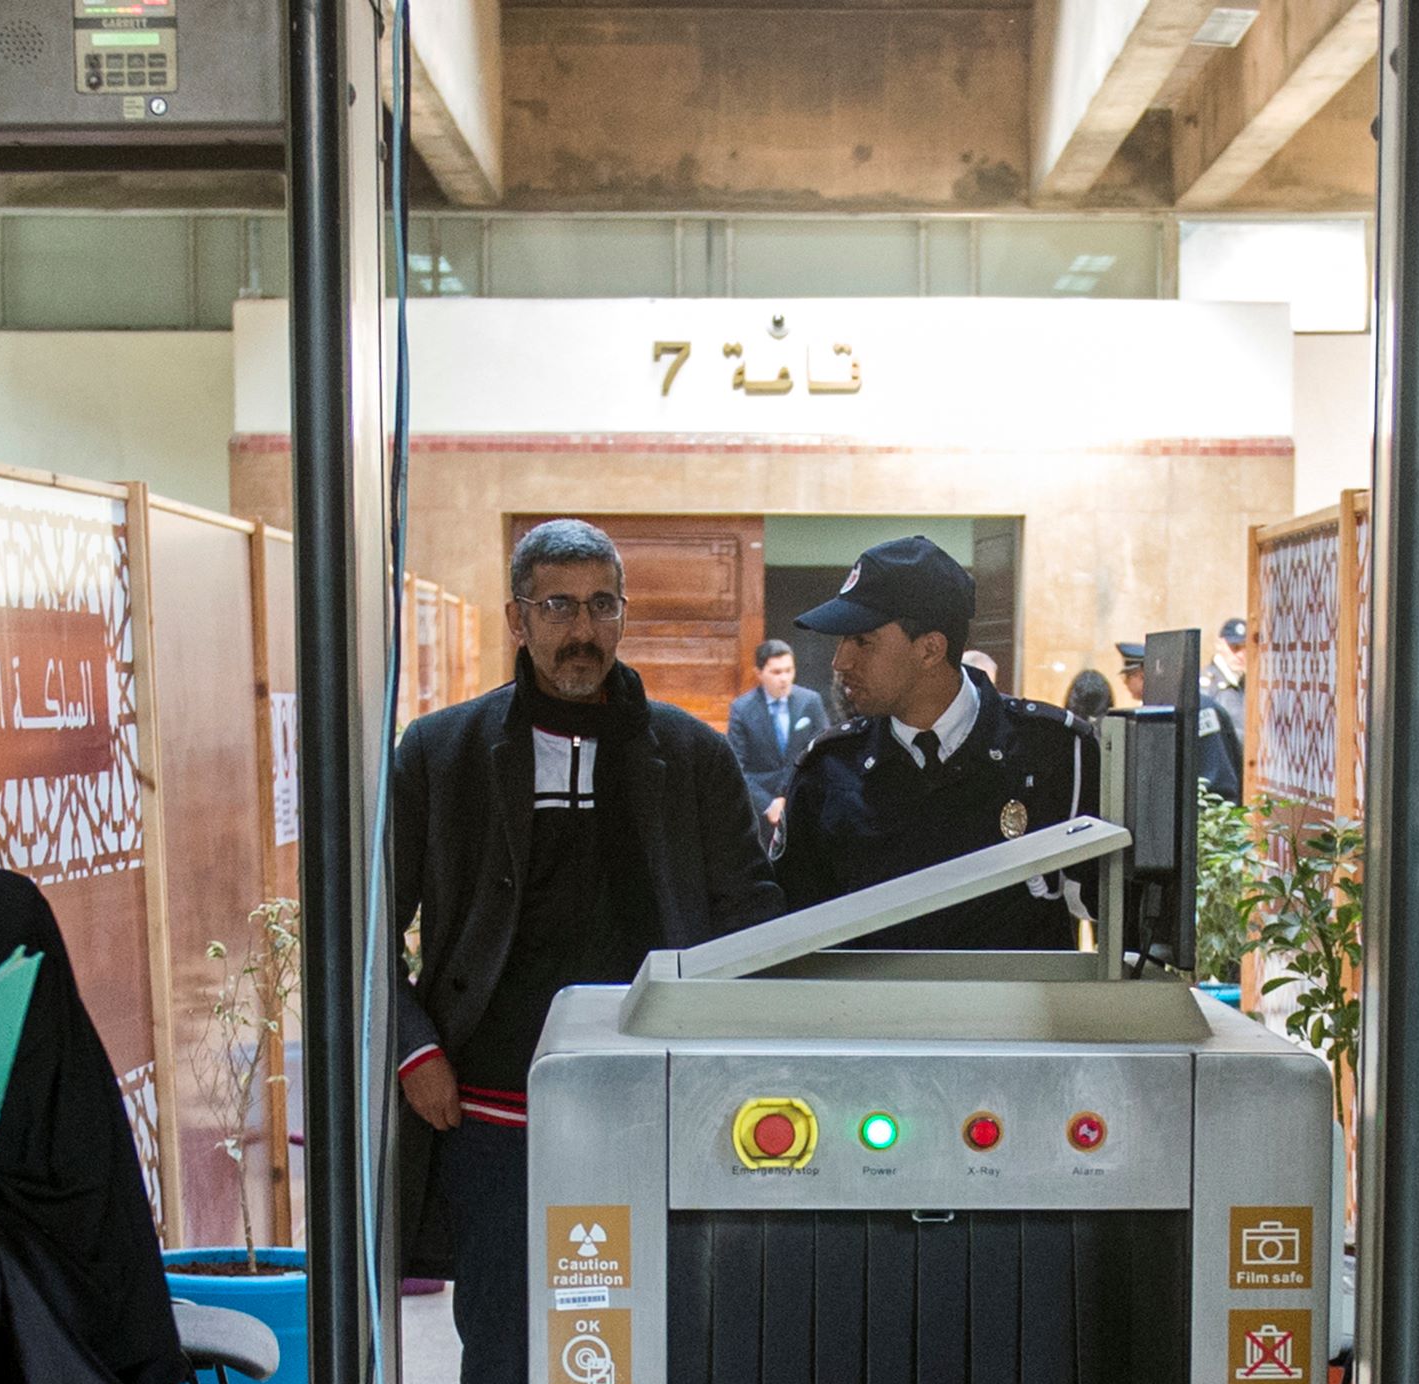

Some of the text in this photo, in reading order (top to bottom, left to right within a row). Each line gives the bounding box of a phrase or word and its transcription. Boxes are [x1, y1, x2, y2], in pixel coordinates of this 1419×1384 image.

[652, 341, 692, 397] 7
[11, 655, 96, 731] المملكة
[862, 1165, 897, 1176] Power
[966, 1165, 1001, 1178] X-Ray
[1071, 1165, 1105, 1176] Alarm
[558, 1258, 619, 1271] Caution
[553, 1273, 624, 1286] radiation
[1236, 1271, 1304, 1284] Film safe
[575, 1320, 600, 1332] OK
